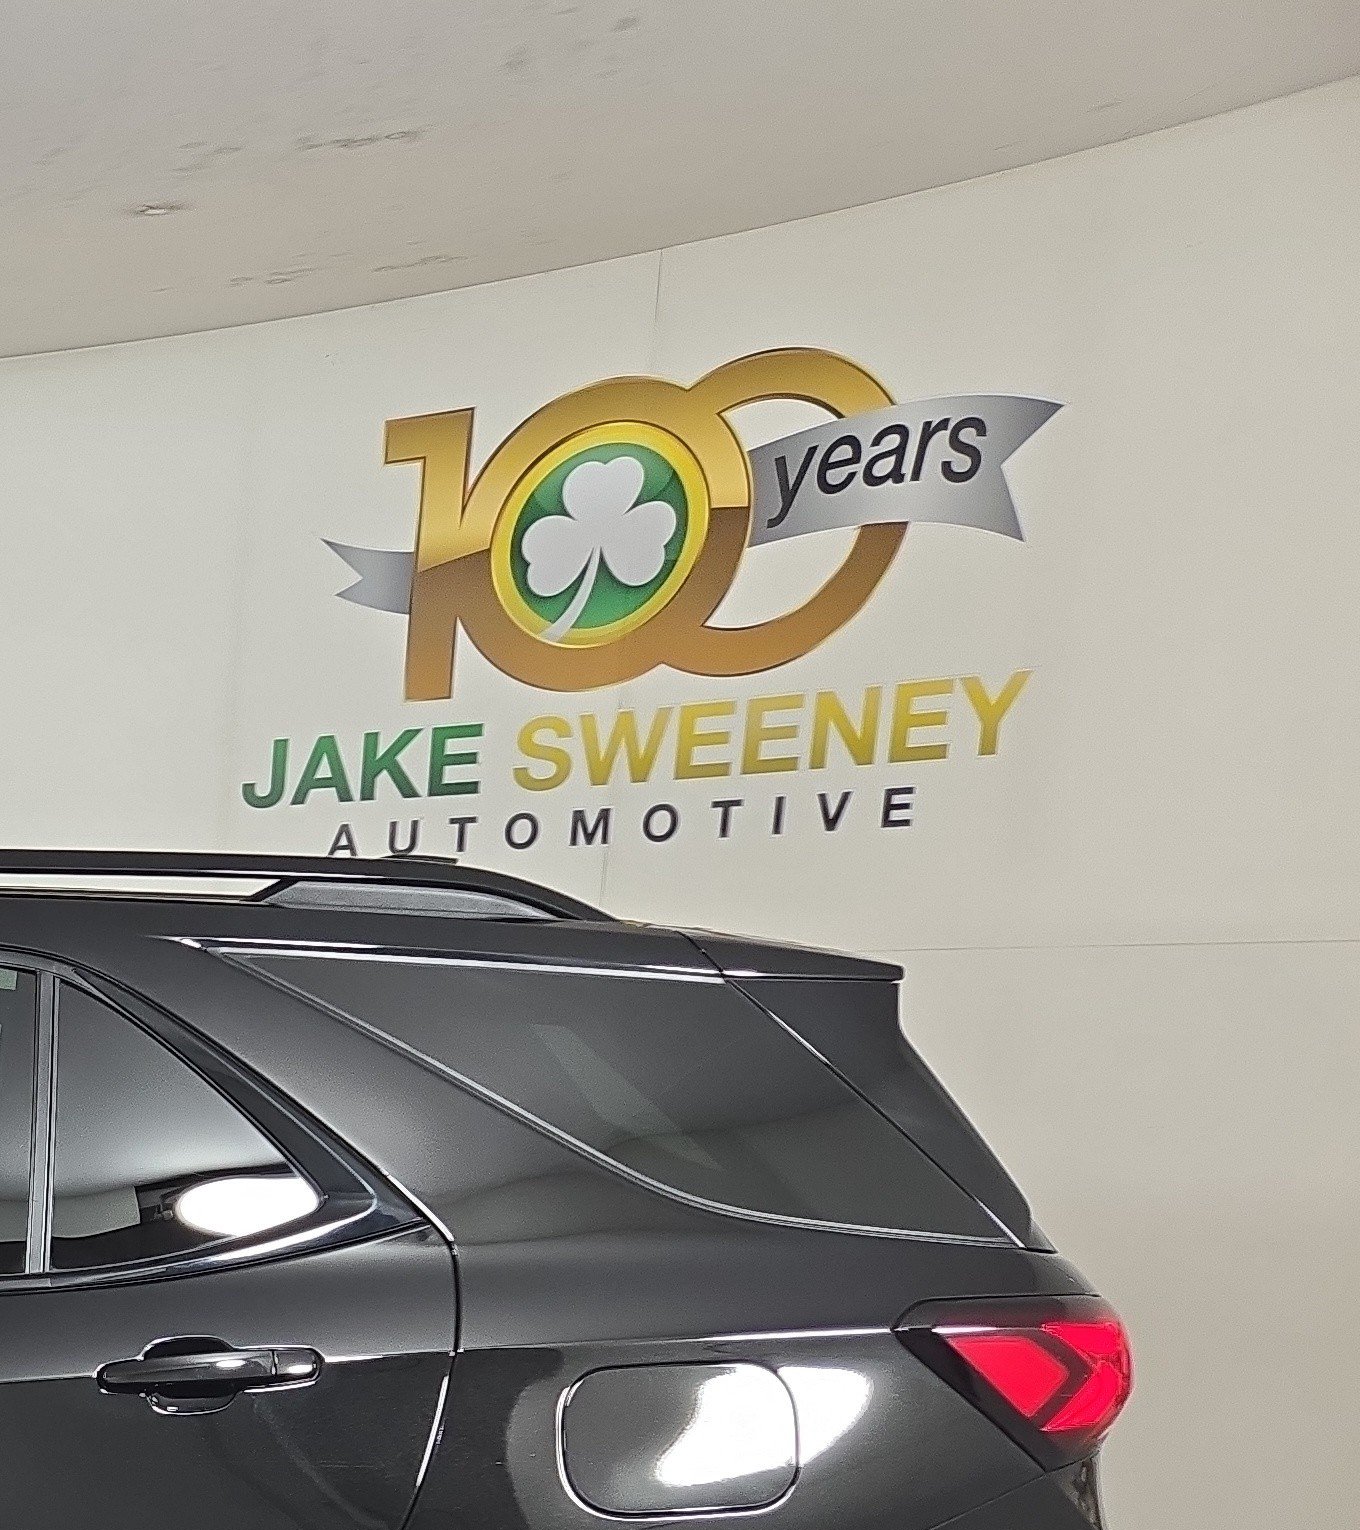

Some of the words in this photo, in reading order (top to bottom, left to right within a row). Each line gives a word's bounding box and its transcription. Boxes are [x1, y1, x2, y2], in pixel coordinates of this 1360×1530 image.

[384, 347, 909, 702] 100
[767, 413, 987, 528] years
[241, 723, 483, 810] JAKE
[512, 669, 1034, 792] SWEENEY
[329, 786, 917, 857] AUTOMOTIVE
